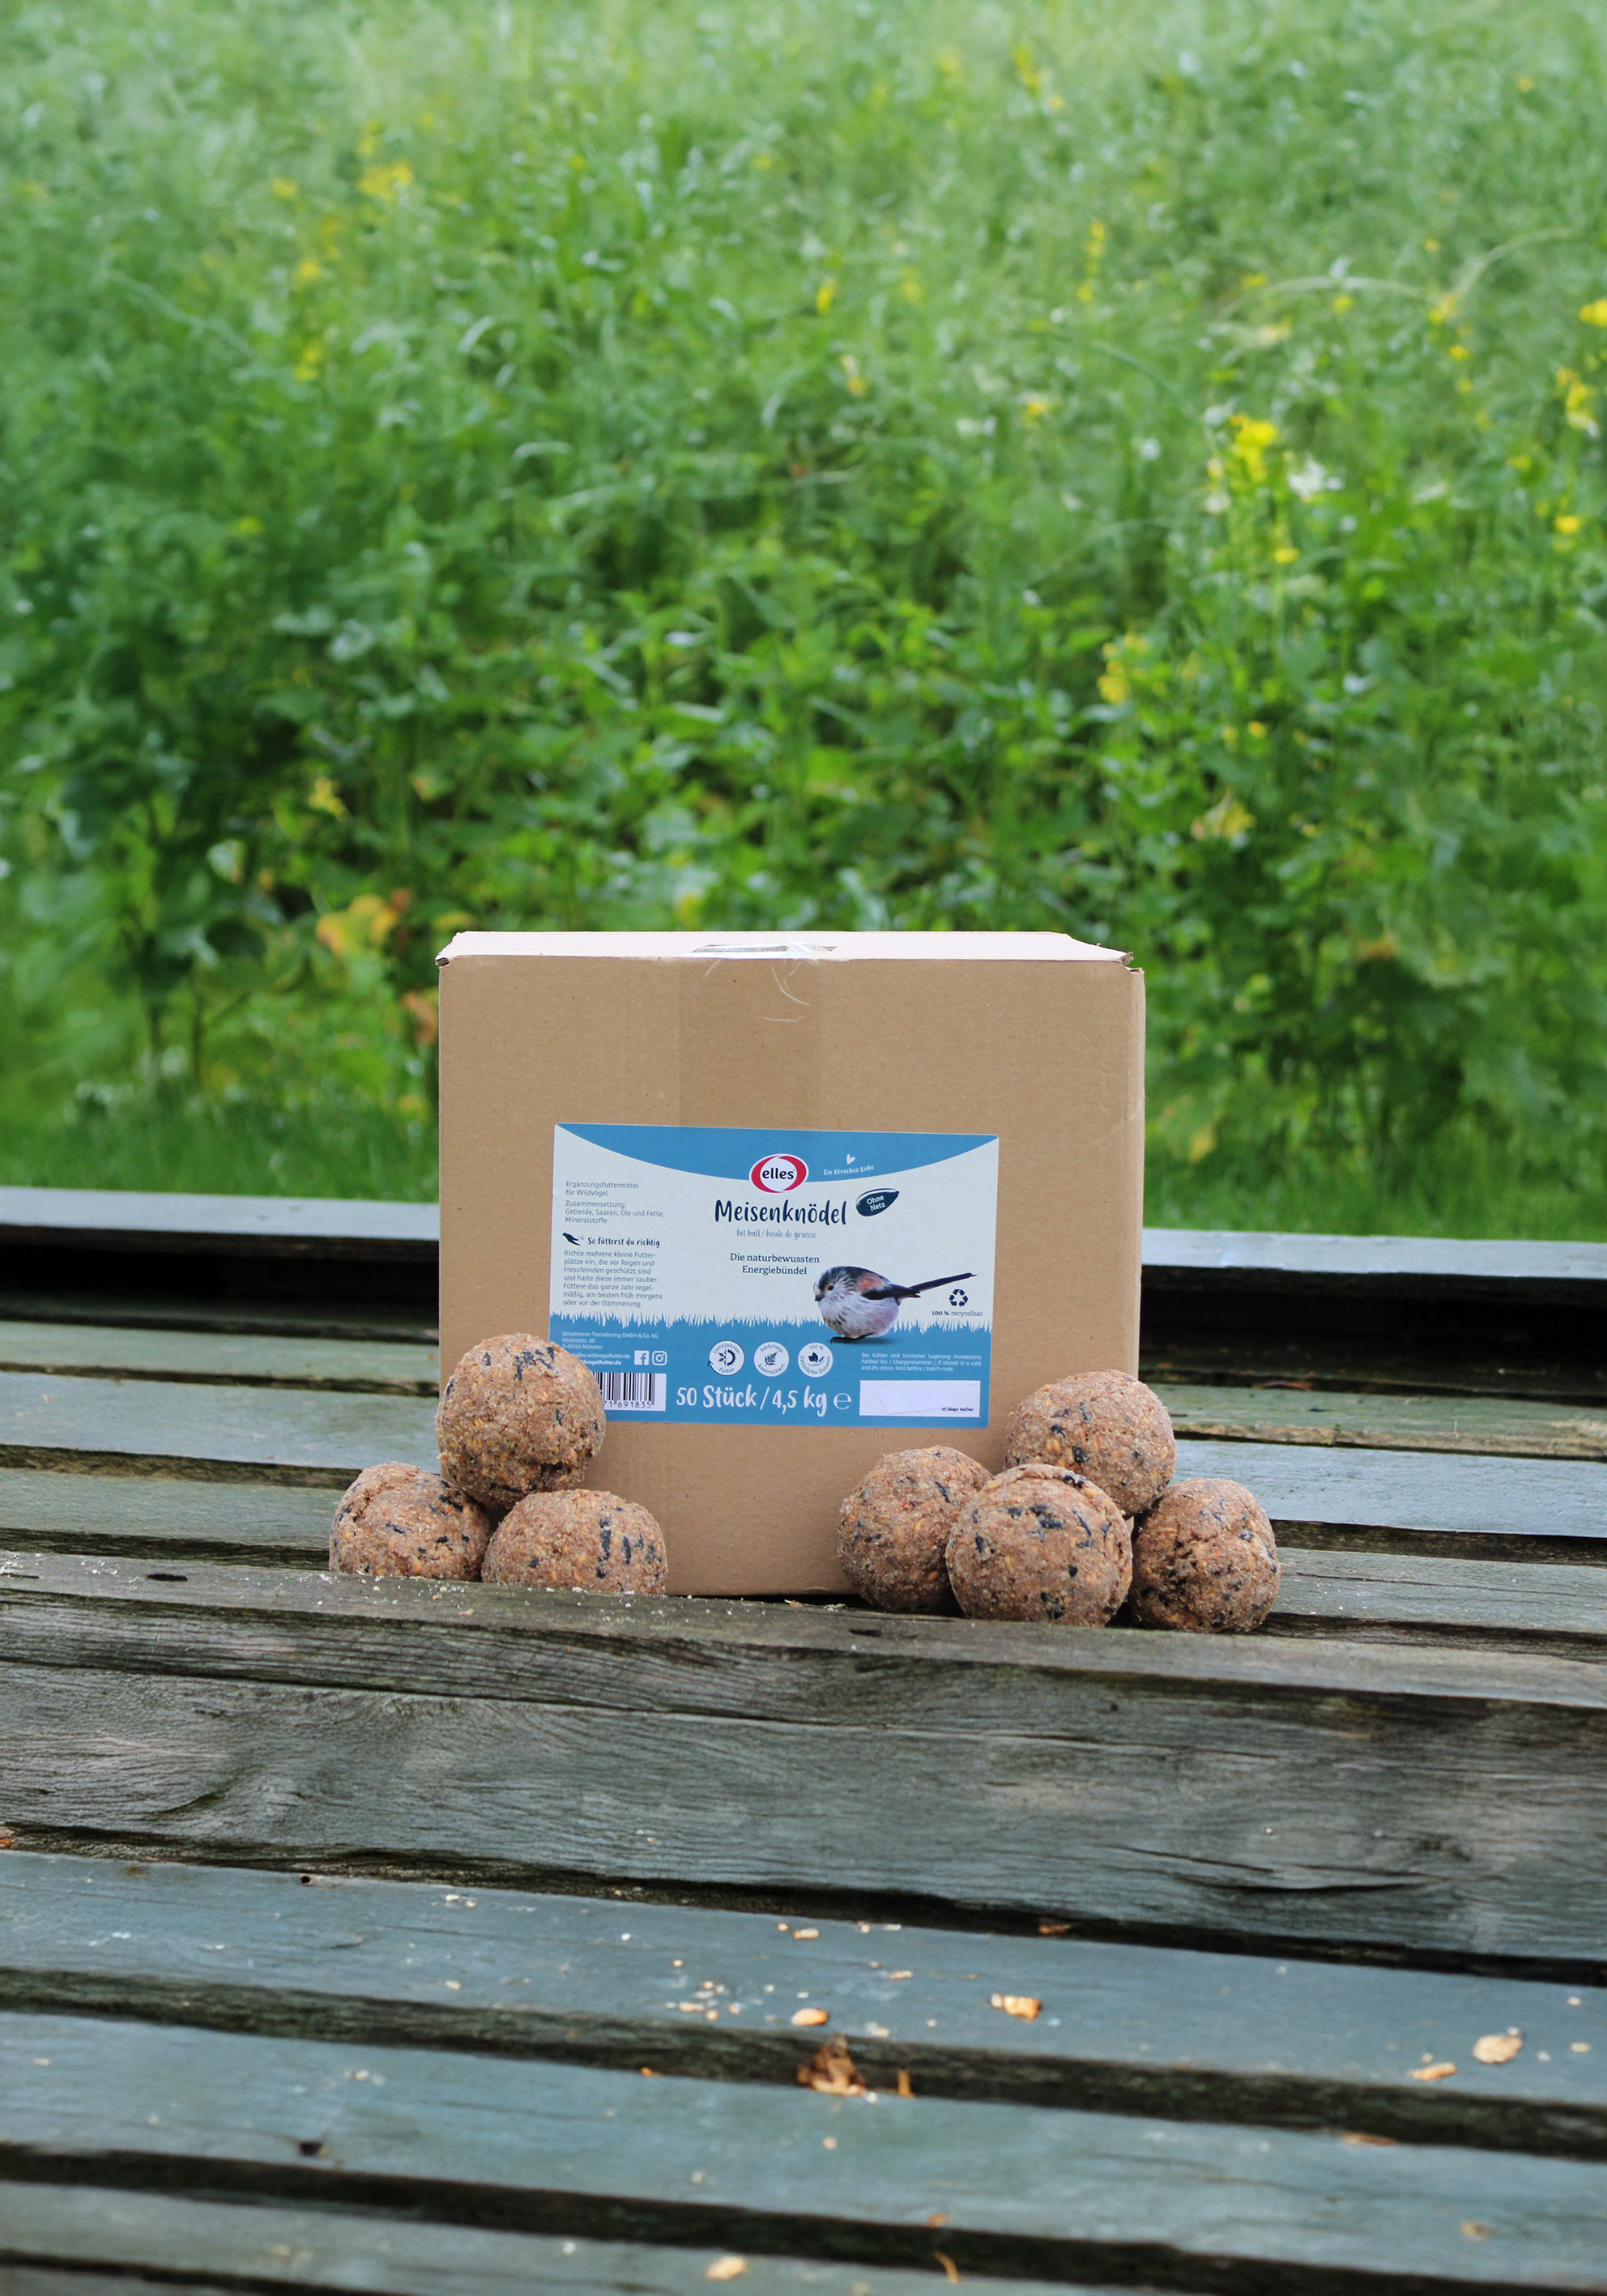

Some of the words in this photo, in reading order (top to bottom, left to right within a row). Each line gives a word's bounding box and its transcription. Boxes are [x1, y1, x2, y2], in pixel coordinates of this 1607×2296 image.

[762, 1168, 794, 1180] elles
[566, 1181, 639, 1189] Ergänzungsfuttermittel
[577, 1190, 608, 1198] Wildvögel
[565, 1200, 626, 1209] Zusammensetzung:
[867, 1195, 884, 1204] Ohne
[714, 1199, 847, 1225] Meisenknödel
[870, 1203, 885, 1212] Netz
[737, 1229, 746, 1237] fat
[748, 1229, 761, 1237] ball
[766, 1229, 783, 1237] boule
[785, 1230, 792, 1238] de
[794, 1232, 816, 1240] graisse
[588, 1237, 595, 1245] So
[599, 1237, 624, 1246] fütterst
[626, 1237, 634, 1246] du
[637, 1238, 660, 1247] richtig
[731, 1253, 745, 1261] Die
[747, 1254, 820, 1263] naturbewussten
[742, 1265, 807, 1276] Energiebündel
[760, 1344, 783, 1353] Ambrosia
[758, 1363, 786, 1374] kontrolliert
[676, 1387, 697, 1406] 50
[703, 1384, 757, 1408] Stück
[761, 1387, 769, 1411] /
[772, 1390, 798, 1415] 4,5
[804, 1386, 827, 1417] kg
